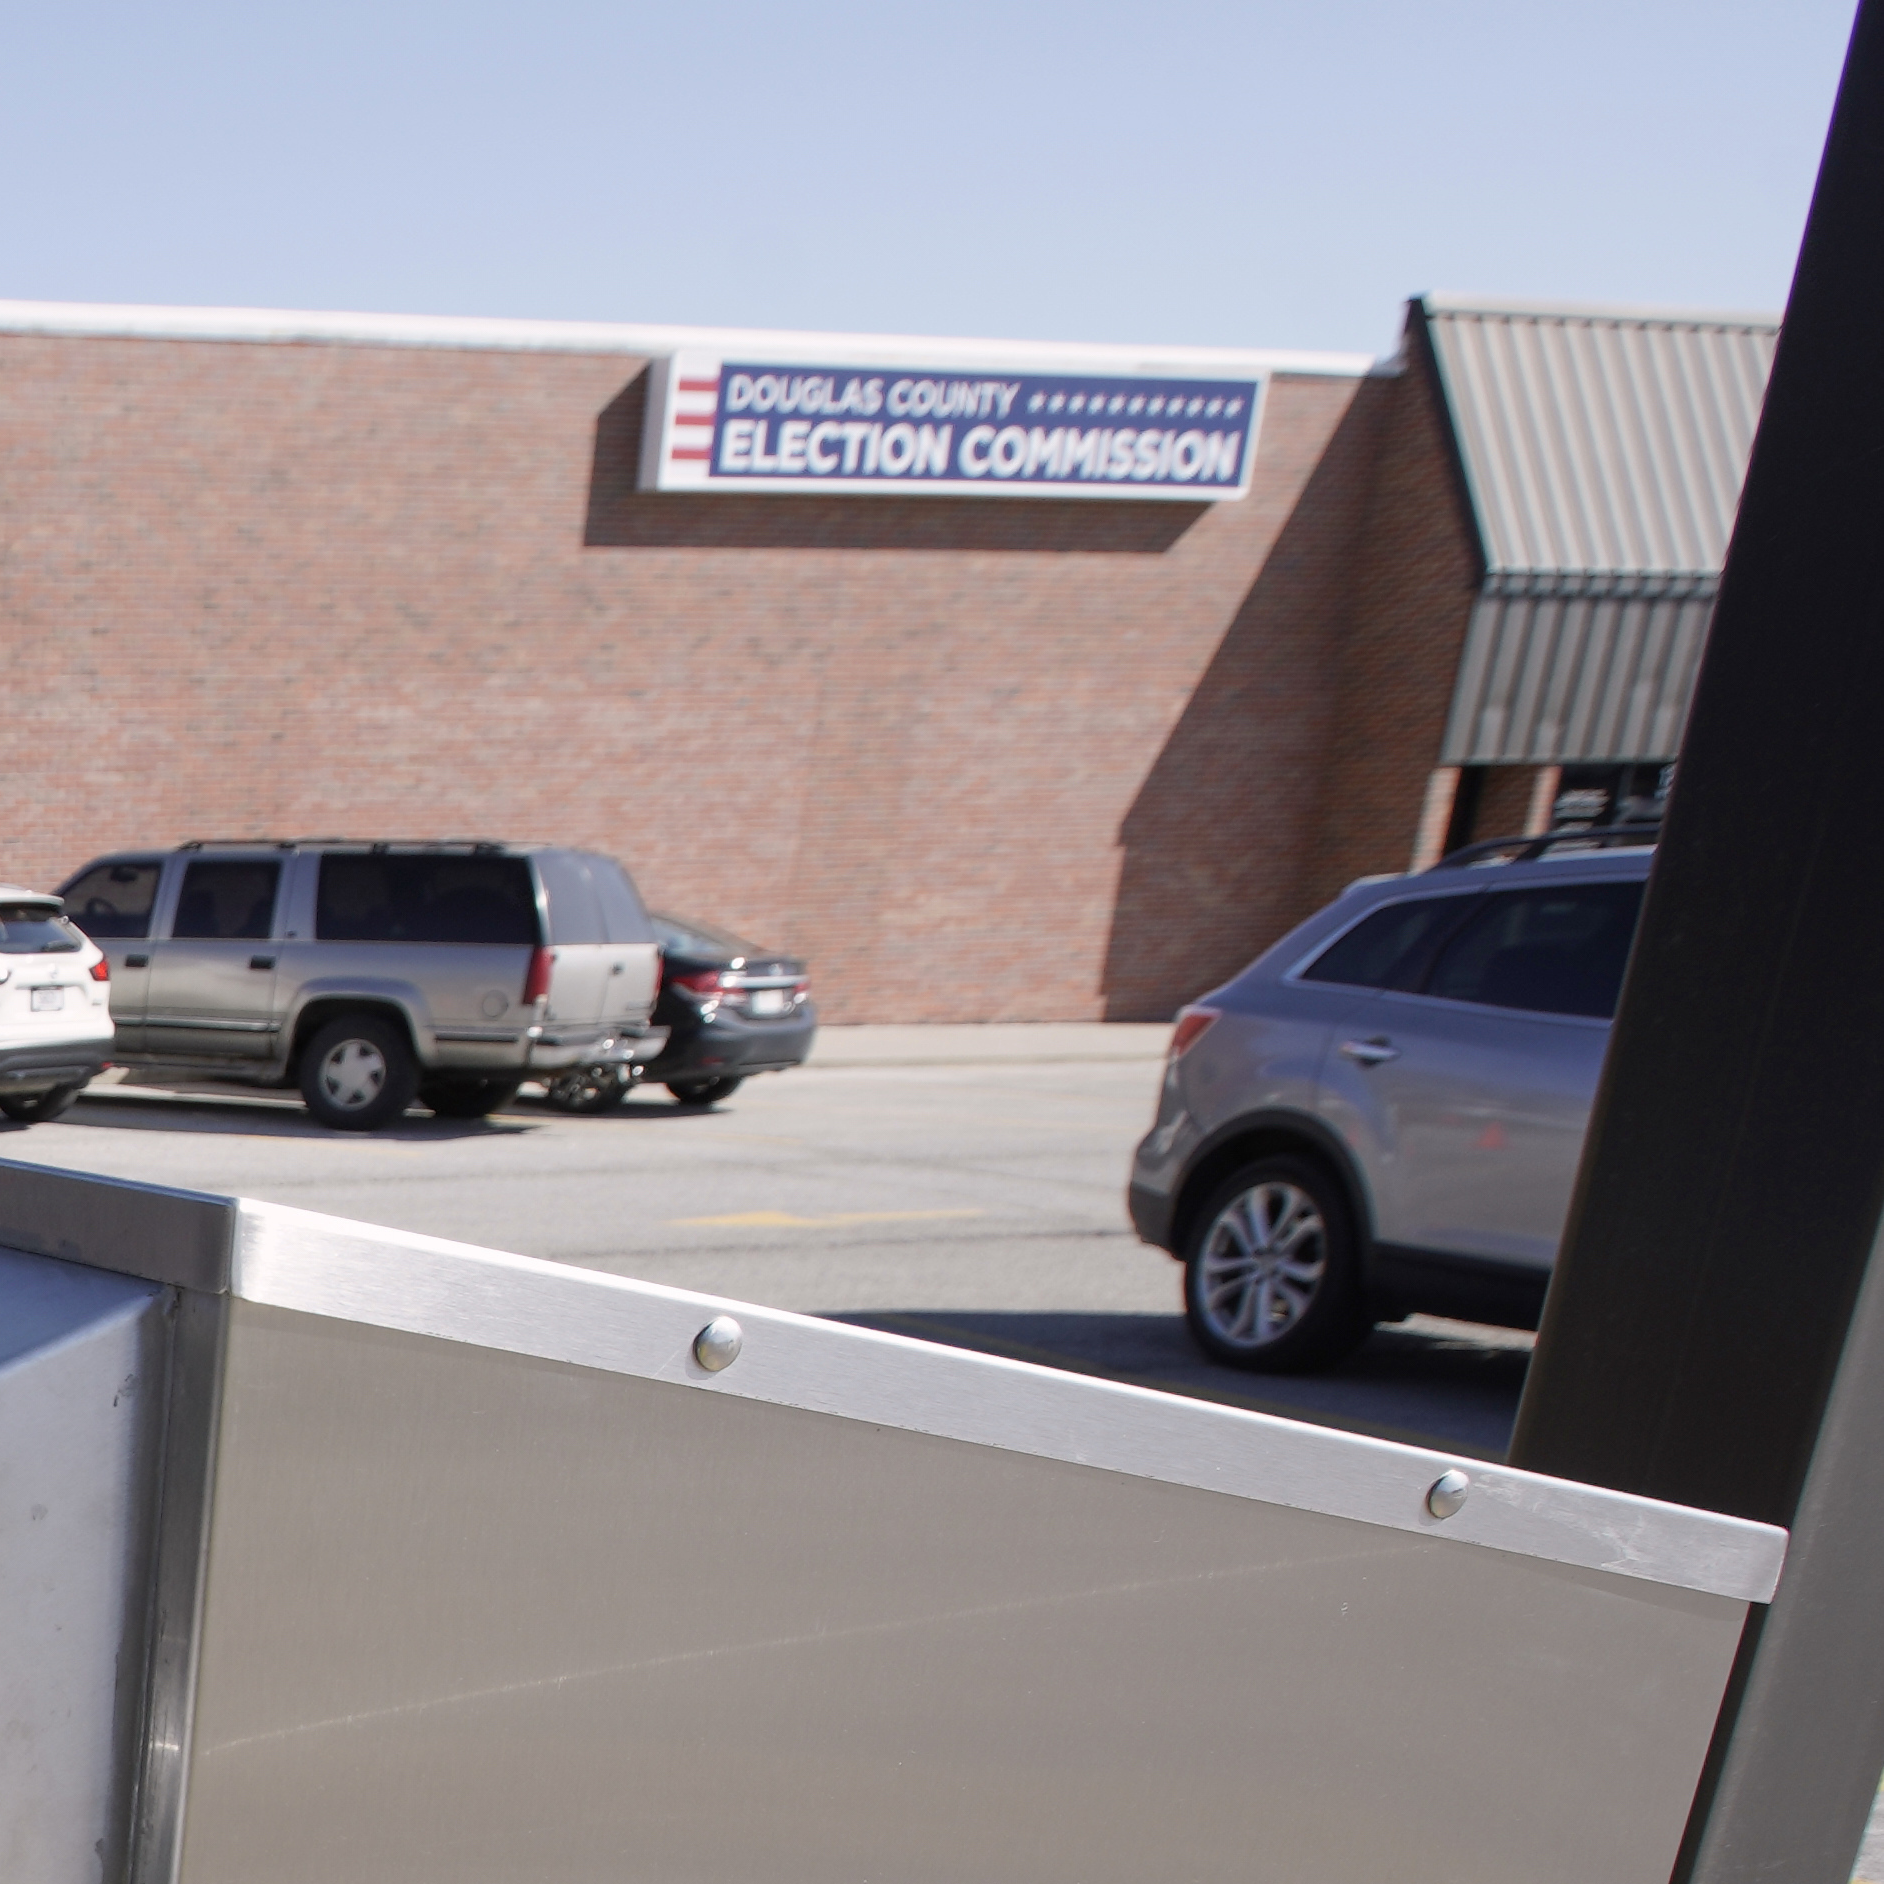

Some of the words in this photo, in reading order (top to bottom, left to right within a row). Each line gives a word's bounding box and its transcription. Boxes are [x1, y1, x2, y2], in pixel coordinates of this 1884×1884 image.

[724, 372, 884, 417] DOUGLAS
[886, 378, 1021, 420] COUNTY
[718, 418, 954, 477] ELECTION
[958, 423, 1242, 483] COMMISSION
